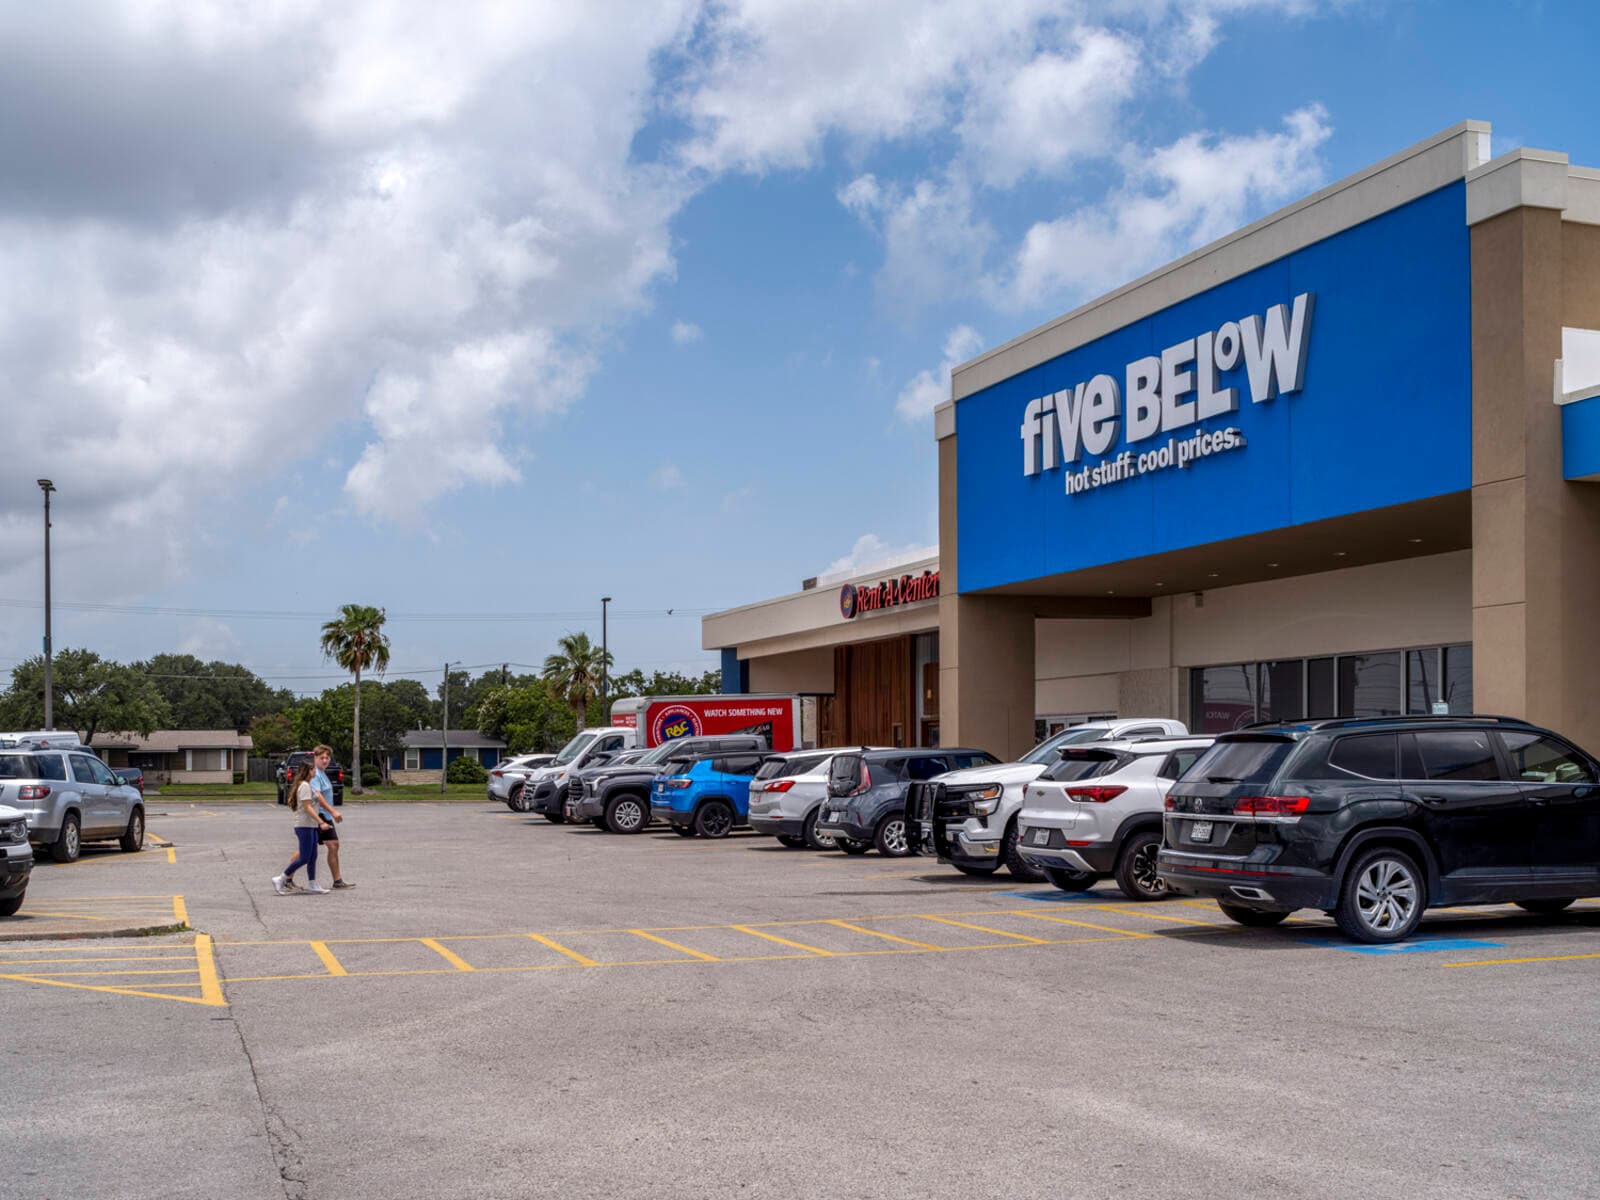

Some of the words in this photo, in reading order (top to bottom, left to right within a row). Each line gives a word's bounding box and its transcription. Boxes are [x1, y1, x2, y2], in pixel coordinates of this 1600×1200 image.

[1020, 374, 1120, 477] five
[1065, 466, 1090, 495] hot
[1092, 452, 1135, 488] stuff.
[1138, 438, 1174, 474] cool
[1178, 427, 1242, 469] prices.
[665, 721, 689, 738] RAC
[704, 708, 727, 717] WATCH
[728, 707, 766, 717] SOMETHING
[767, 707, 783, 716] NEW
